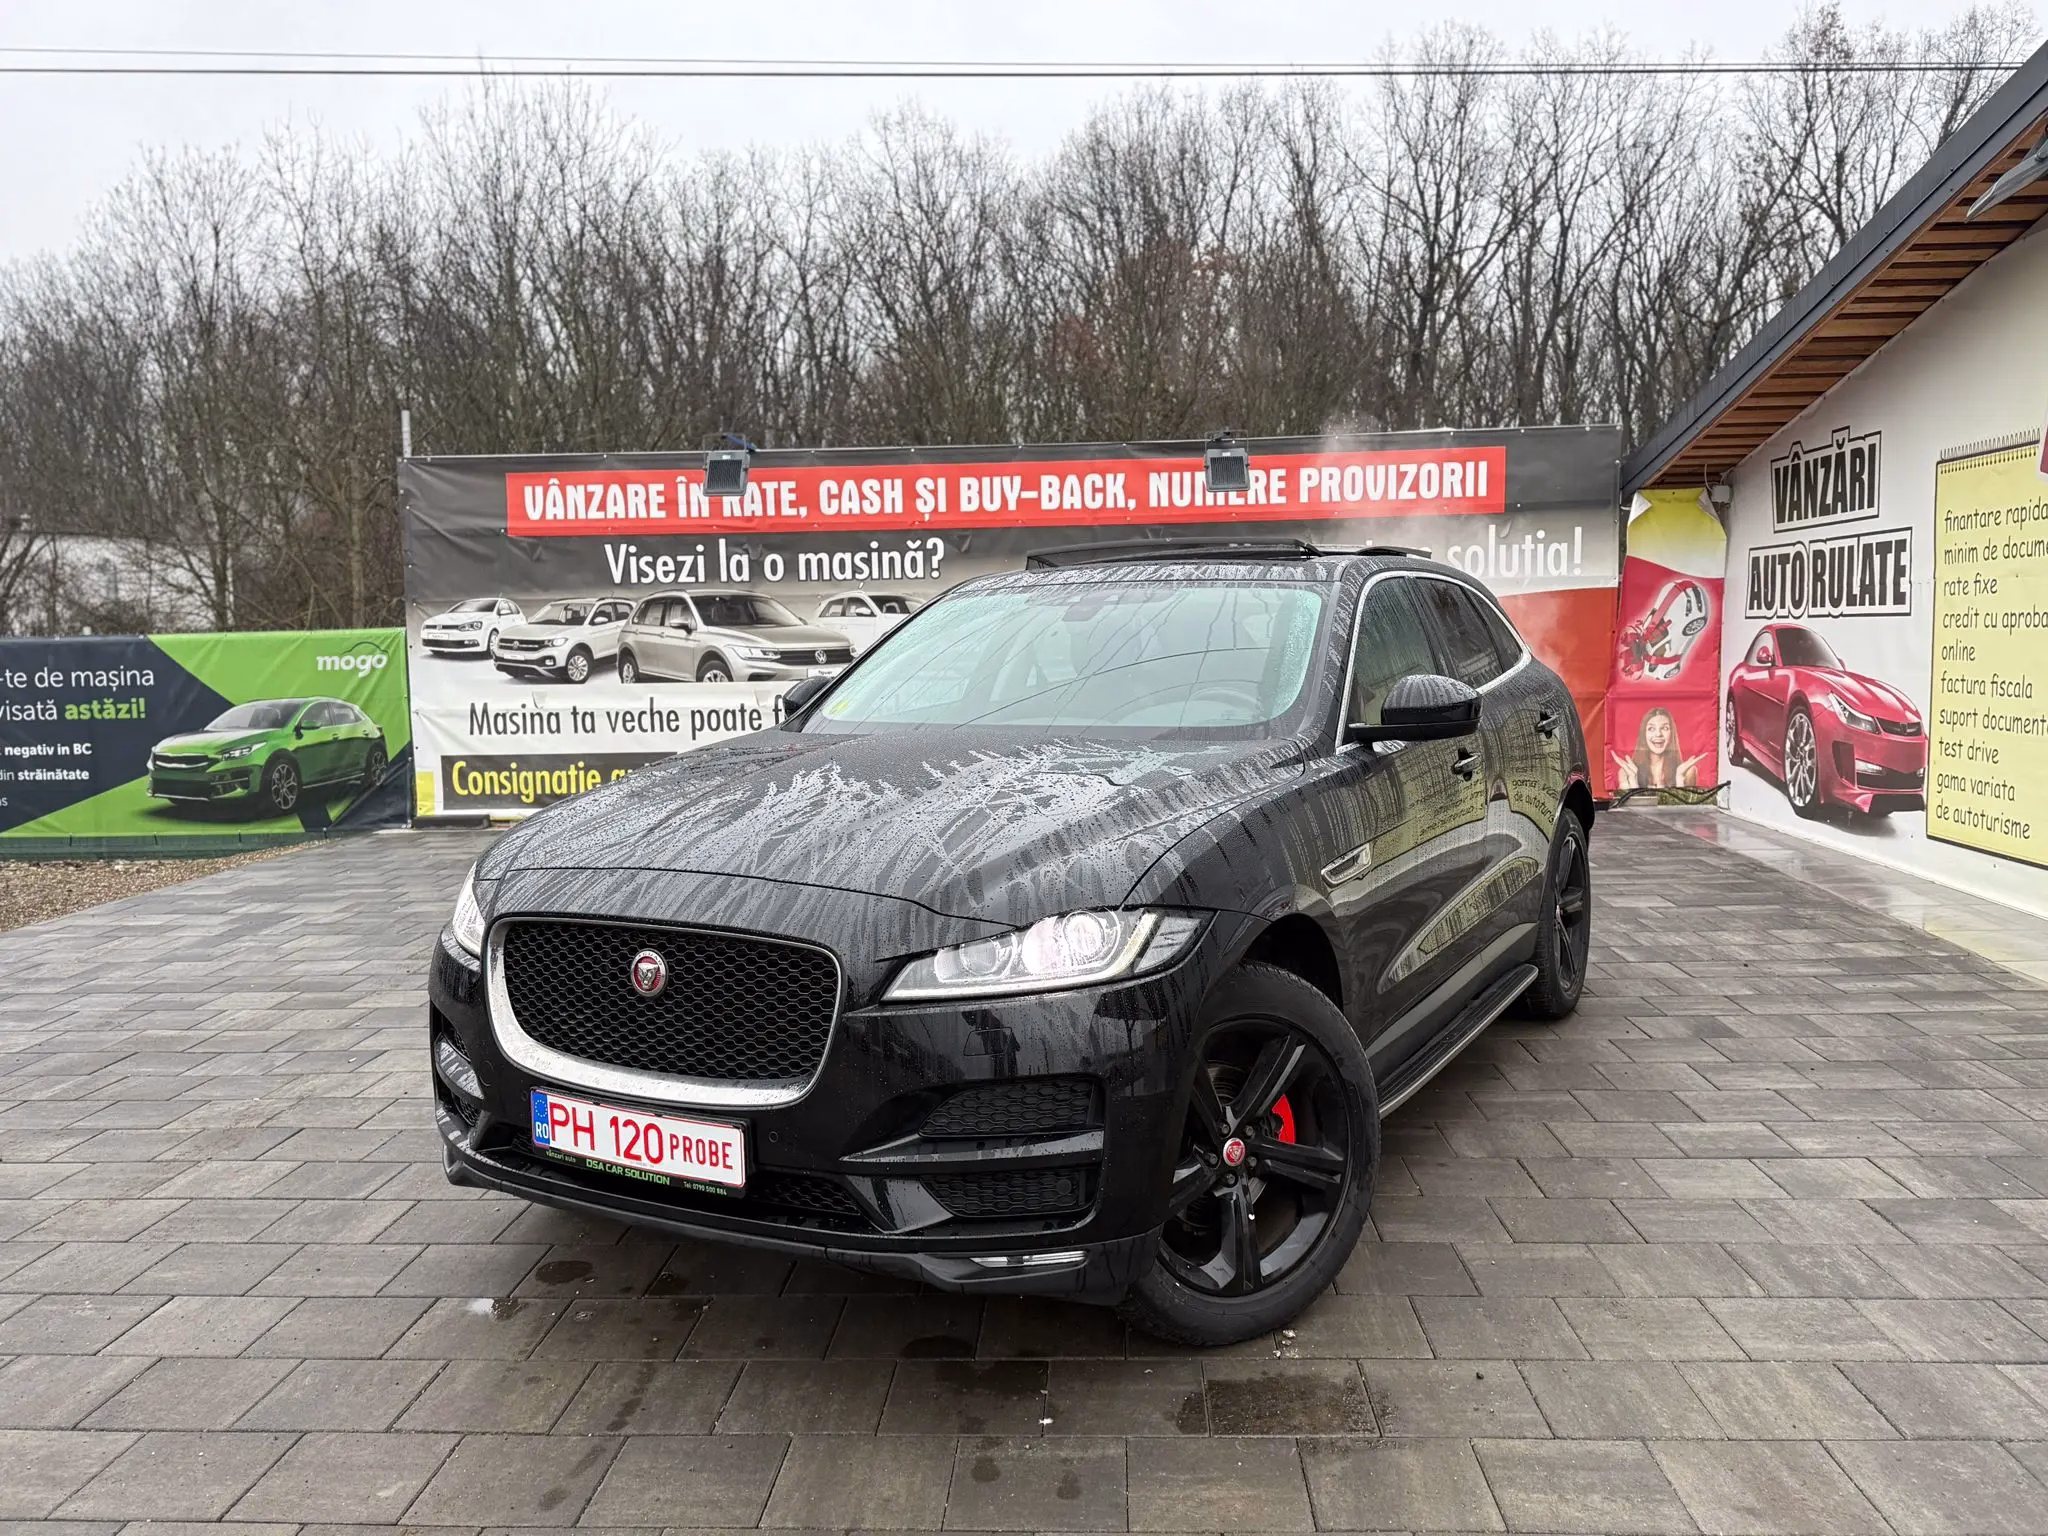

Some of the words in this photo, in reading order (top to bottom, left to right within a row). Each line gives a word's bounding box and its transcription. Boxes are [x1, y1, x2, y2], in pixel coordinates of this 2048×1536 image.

[523, 477, 667, 521] VÂNZARE
[675, 475, 710, 518] ÎN
[818, 478, 904, 516] CASH
[914, 476, 947, 522] ȘI
[959, 472, 1137, 512] BUY-BACK,
[1299, 460, 1488, 504] PROVIZORII
[1774, 436, 1877, 525] VÂNZĂRI
[1944, 508, 2002, 534] finantare
[603, 543, 706, 585] Visezi
[718, 538, 750, 583] la
[763, 553, 785, 583] o
[798, 536, 945, 589] mașină?
[1944, 541, 1979, 565] minim
[1982, 537, 1999, 561] de
[2002, 535, 2048, 560] docum
[1748, 549, 1806, 612] AUTO
[1811, 538, 1908, 610] RULATE
[1943, 576, 1970, 597] rate
[1973, 571, 1998, 597] fixe
[1942, 605, 1980, 629] credit
[1983, 612, 1998, 629] cu
[1941, 638, 1977, 662] online
[34, 666, 64, 688] de
[70, 664, 155, 692] mașina
[315, 653, 389, 678] mogo
[1940, 670, 1986, 696] factura
[1990, 673, 2033, 699] fiscala
[64, 697, 147, 720] astăzi!
[468, 702, 561, 736] Masina
[570, 705, 596, 734] ta
[605, 696, 681, 734] veche
[690, 702, 763, 741] poate
[1939, 707, 1979, 733] suport
[1982, 706, 2048, 737] document
[4, 743, 55, 758] negativ
[56, 743, 70, 756] in
[72, 742, 93, 755] BC
[1938, 736, 1964, 760] test
[1966, 738, 2000, 765] drive
[17, 767, 90, 781] străinătate
[1936, 773, 1966, 794] gama
[1970, 776, 2015, 802] variata
[1935, 797, 1950, 821] de
[1952, 806, 2031, 840] autoturisme
[535, 1121, 549, 1139] RO
[548, 1101, 596, 1152] PH
[609, 1115, 664, 1165] 120
[669, 1133, 734, 1170] PROBE
[605, 1163, 624, 1176] CAR
[624, 1168, 671, 1186] SOLUTION
